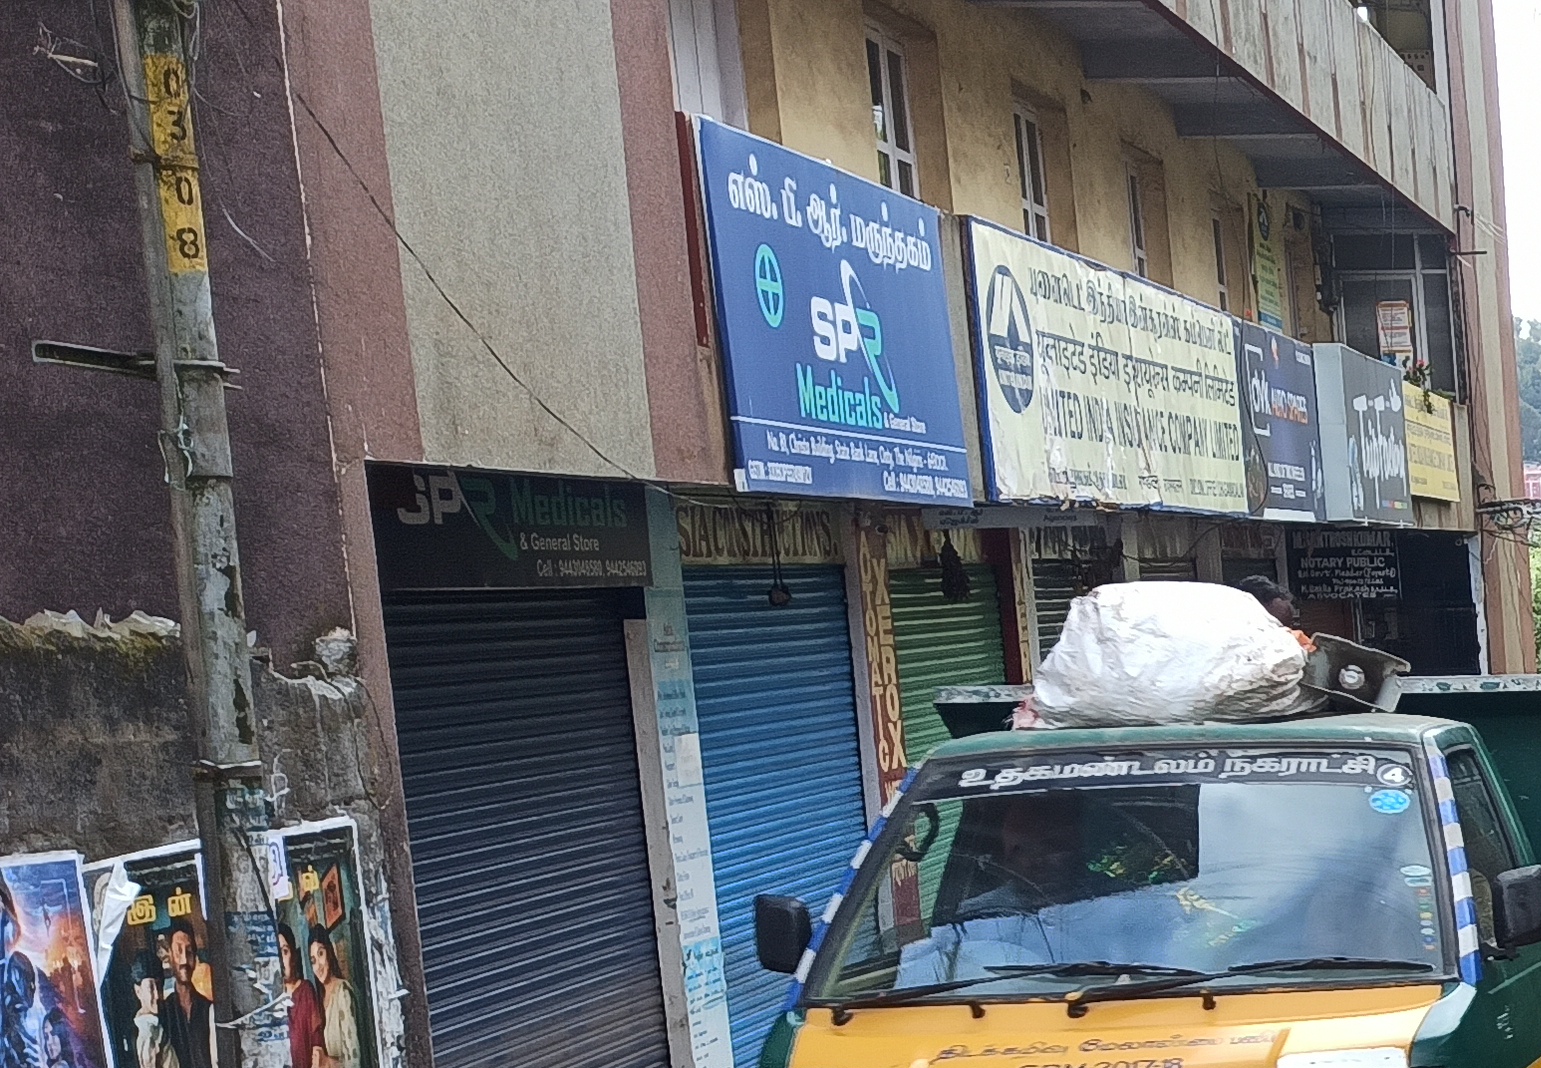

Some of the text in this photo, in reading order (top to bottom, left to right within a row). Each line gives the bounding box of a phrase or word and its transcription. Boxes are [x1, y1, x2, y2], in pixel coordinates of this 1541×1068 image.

[851, 202, 931, 273] மருந்தகம்
[796, 363, 884, 429] Medicals
[1168, 412, 1209, 457] COMPANY
[1211, 418, 1240, 462] LIMITED
[510, 477, 627, 528] Medicals
[520, 533, 599, 550] & General Store
[1301, 557, 1385, 568] NOTARY PUBLIC
[859, 530, 889, 773] AUTOMATIC
[872, 558, 906, 768] XEROX
[958, 755, 1214, 790] உதகமண்டலம்
[1223, 752, 1377, 780] நகராட்சி
